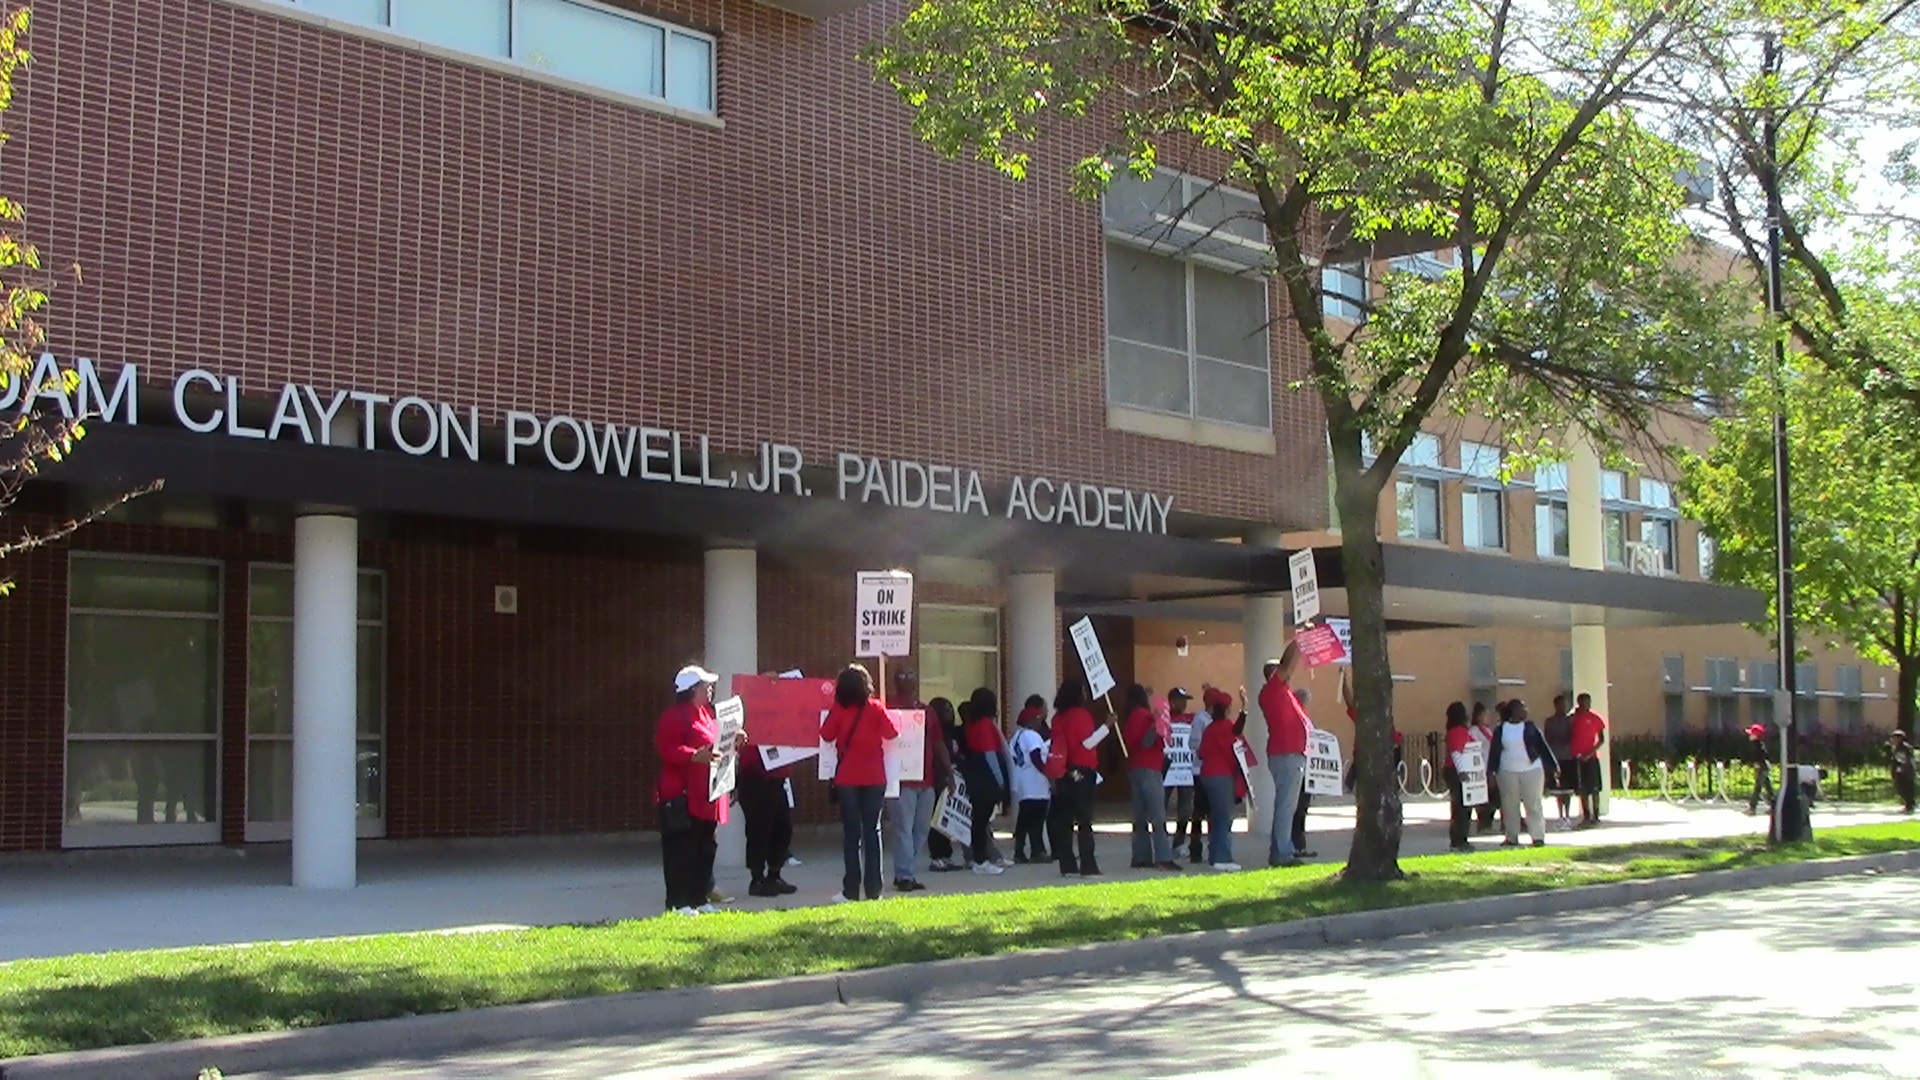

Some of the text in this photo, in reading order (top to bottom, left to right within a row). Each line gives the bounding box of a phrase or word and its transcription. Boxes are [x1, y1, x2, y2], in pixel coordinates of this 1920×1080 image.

[173, 369, 479, 462] CLAYTON
[506, 410, 738, 488] POWELL,
[748, 441, 812, 496] JR.
[837, 453, 989, 517] PAIDEIA
[1006, 475, 1174, 535] ACADEMY
[1299, 566, 1308, 580] ON
[877, 589, 894, 605] ON
[1295, 580, 1316, 600] STRIKE
[862, 609, 906, 627] STRIKE
[1318, 741, 1330, 755] ON
[1309, 757, 1339, 772] STRIKE
[946, 795, 972, 818] STRIK
